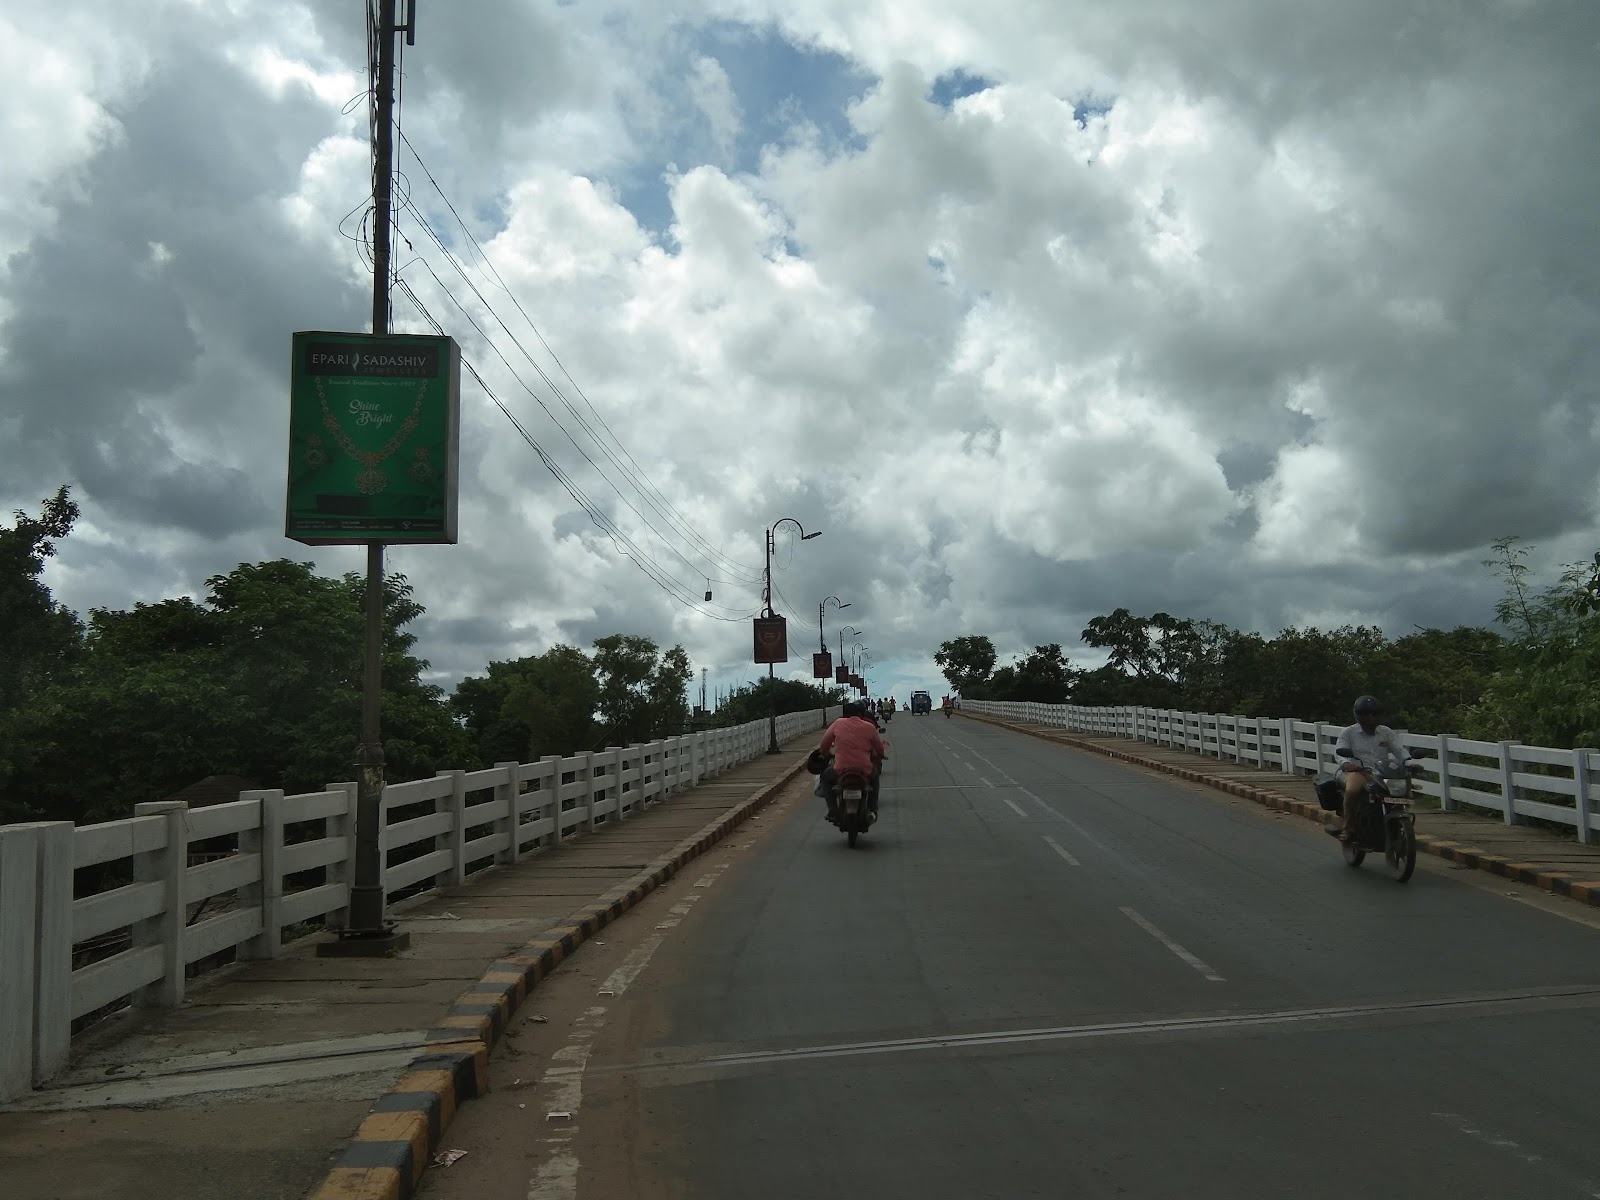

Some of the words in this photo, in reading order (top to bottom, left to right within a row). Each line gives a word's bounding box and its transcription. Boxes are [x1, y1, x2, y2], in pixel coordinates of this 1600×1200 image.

[312, 353, 349, 365] EPARI
[363, 355, 427, 366] SADASHIV
[349, 399, 380, 414] Shine
[356, 411, 393, 429] Bright
